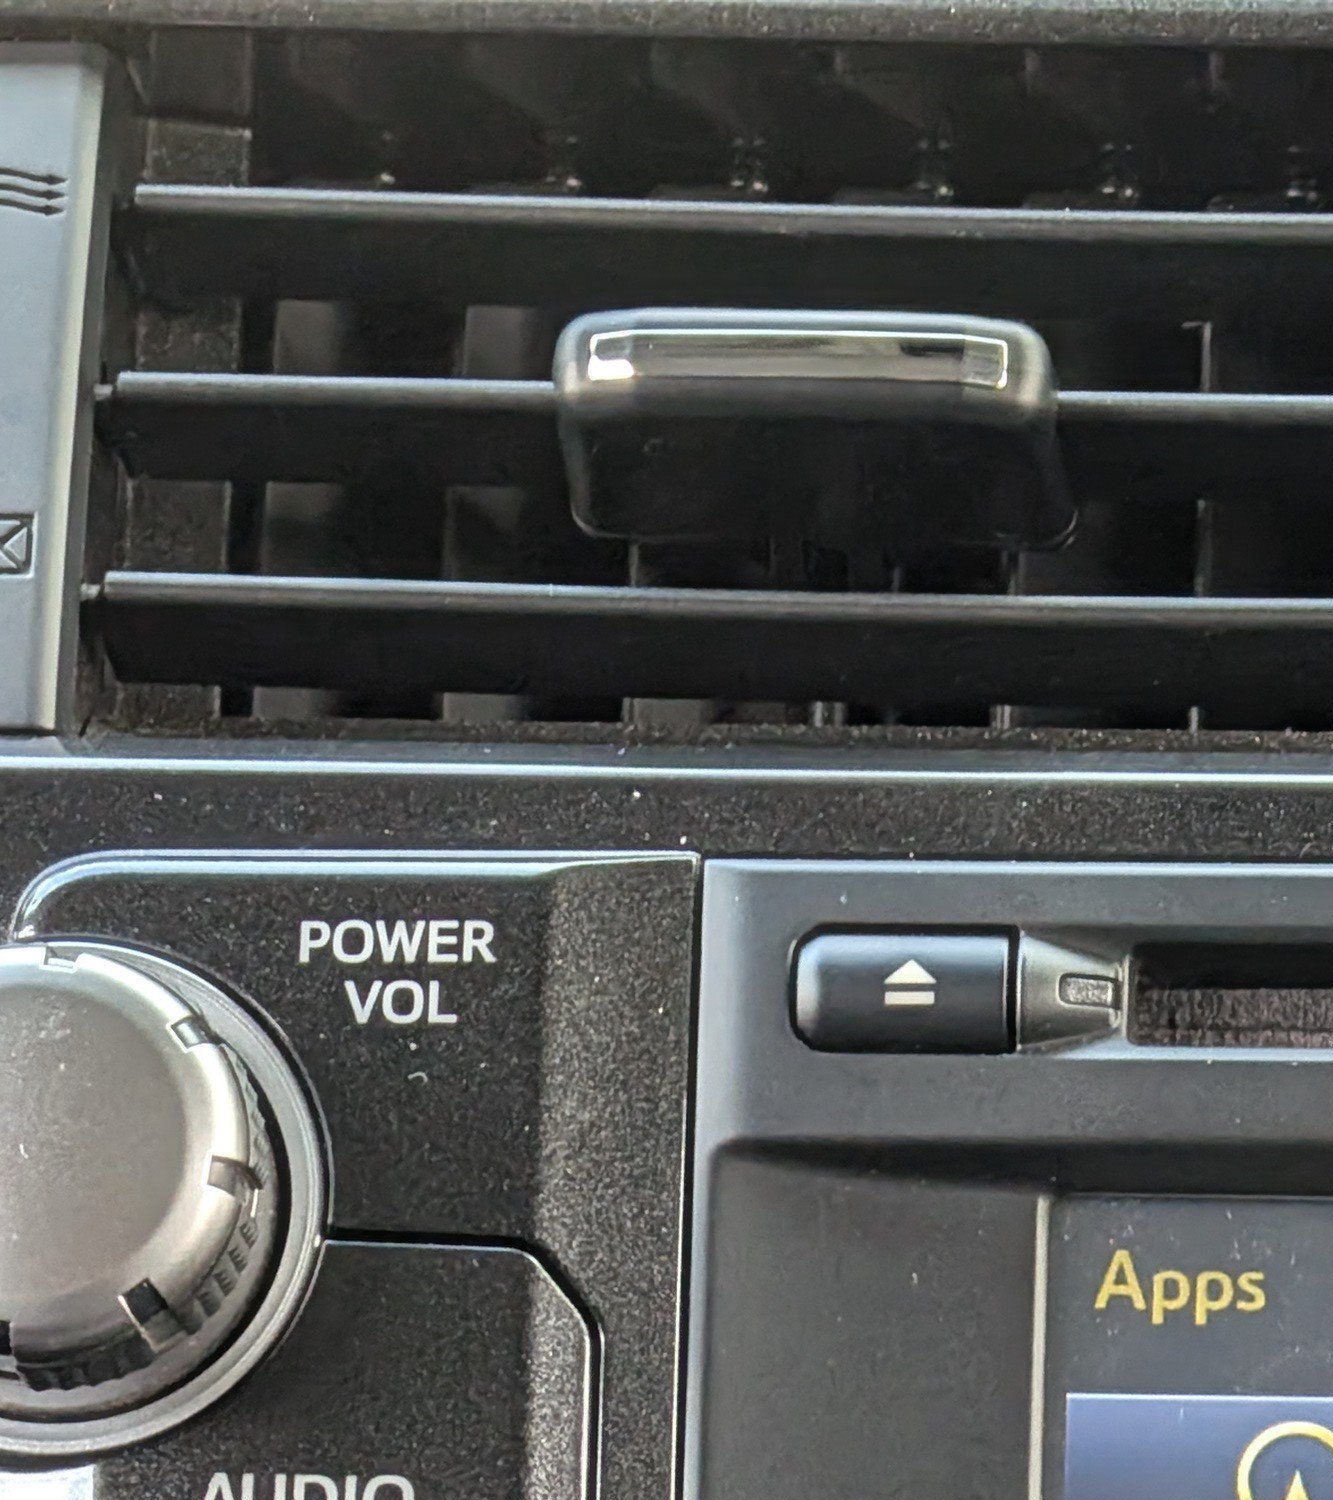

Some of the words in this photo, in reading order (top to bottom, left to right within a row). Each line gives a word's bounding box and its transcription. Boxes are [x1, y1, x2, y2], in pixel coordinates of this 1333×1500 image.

[298, 918, 497, 964] POWER
[344, 979, 458, 1025] VOL
[1094, 1249, 1266, 1326] Apps
